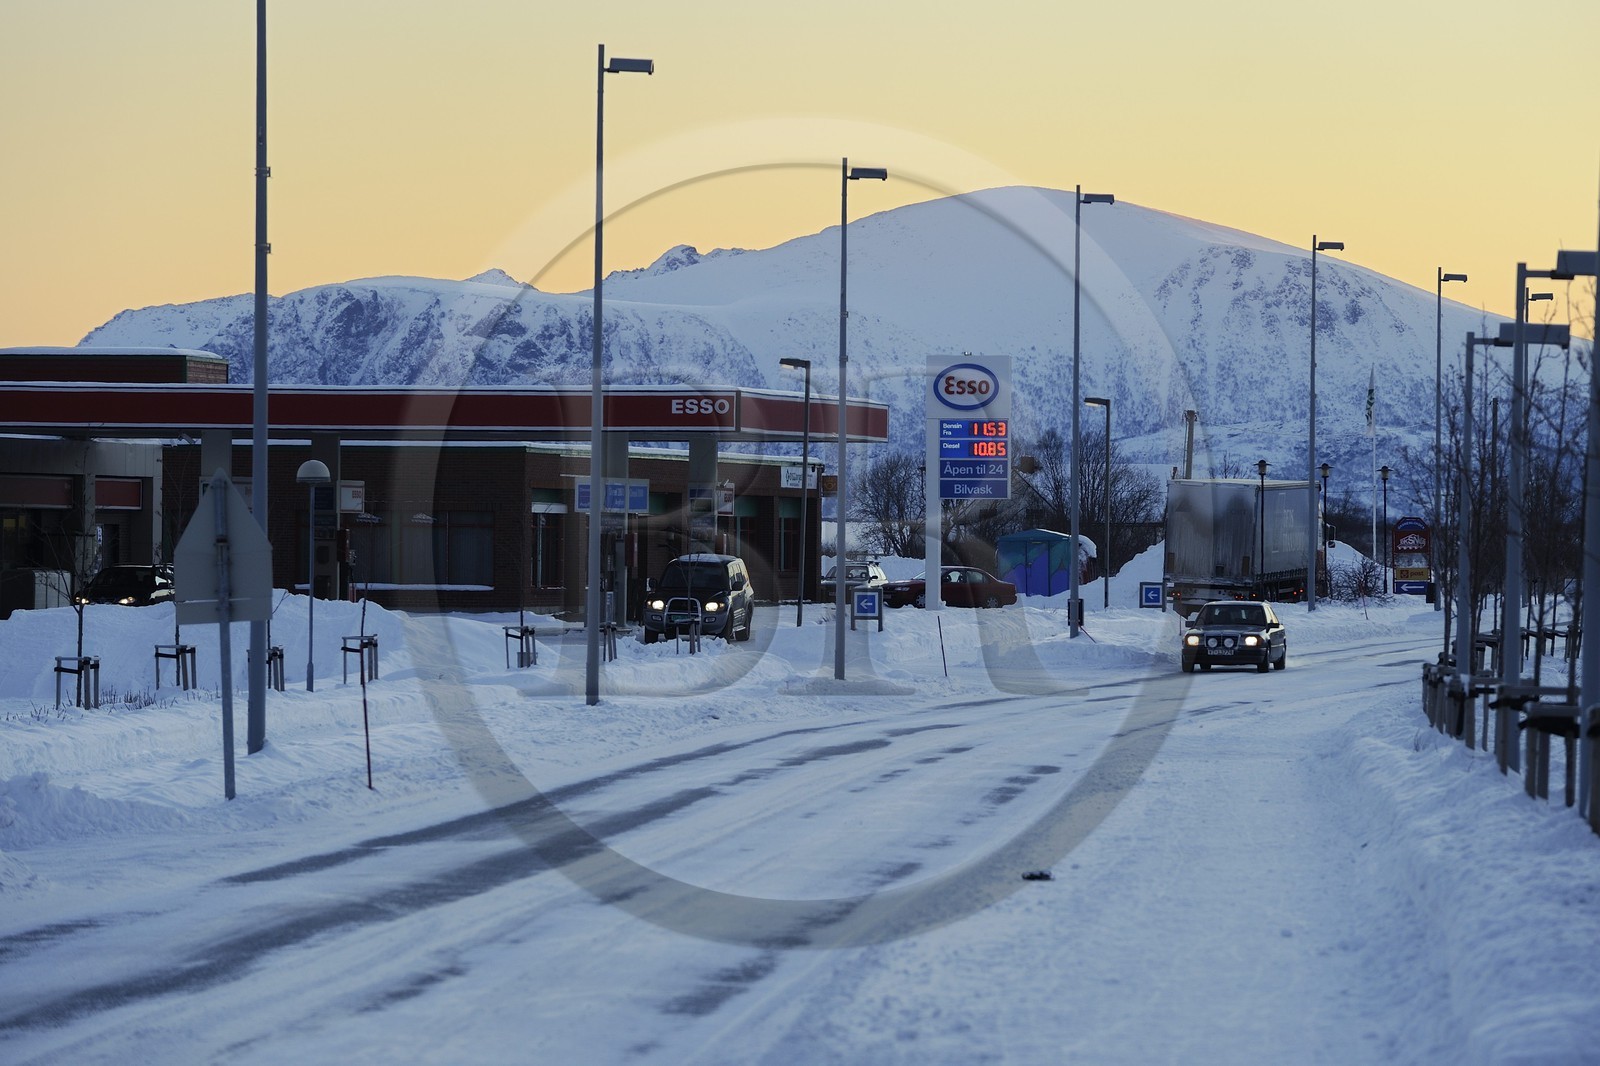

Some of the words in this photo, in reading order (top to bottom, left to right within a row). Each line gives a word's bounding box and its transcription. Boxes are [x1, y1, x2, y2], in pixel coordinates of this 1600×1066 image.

[671, 398, 730, 415] ESSO
[944, 461, 973, 476] Åpen
[975, 464, 986, 475] til
[988, 464, 1004, 475] 24
[954, 483, 993, 495] Bilvask
[1410, 570, 1424, 578] post
